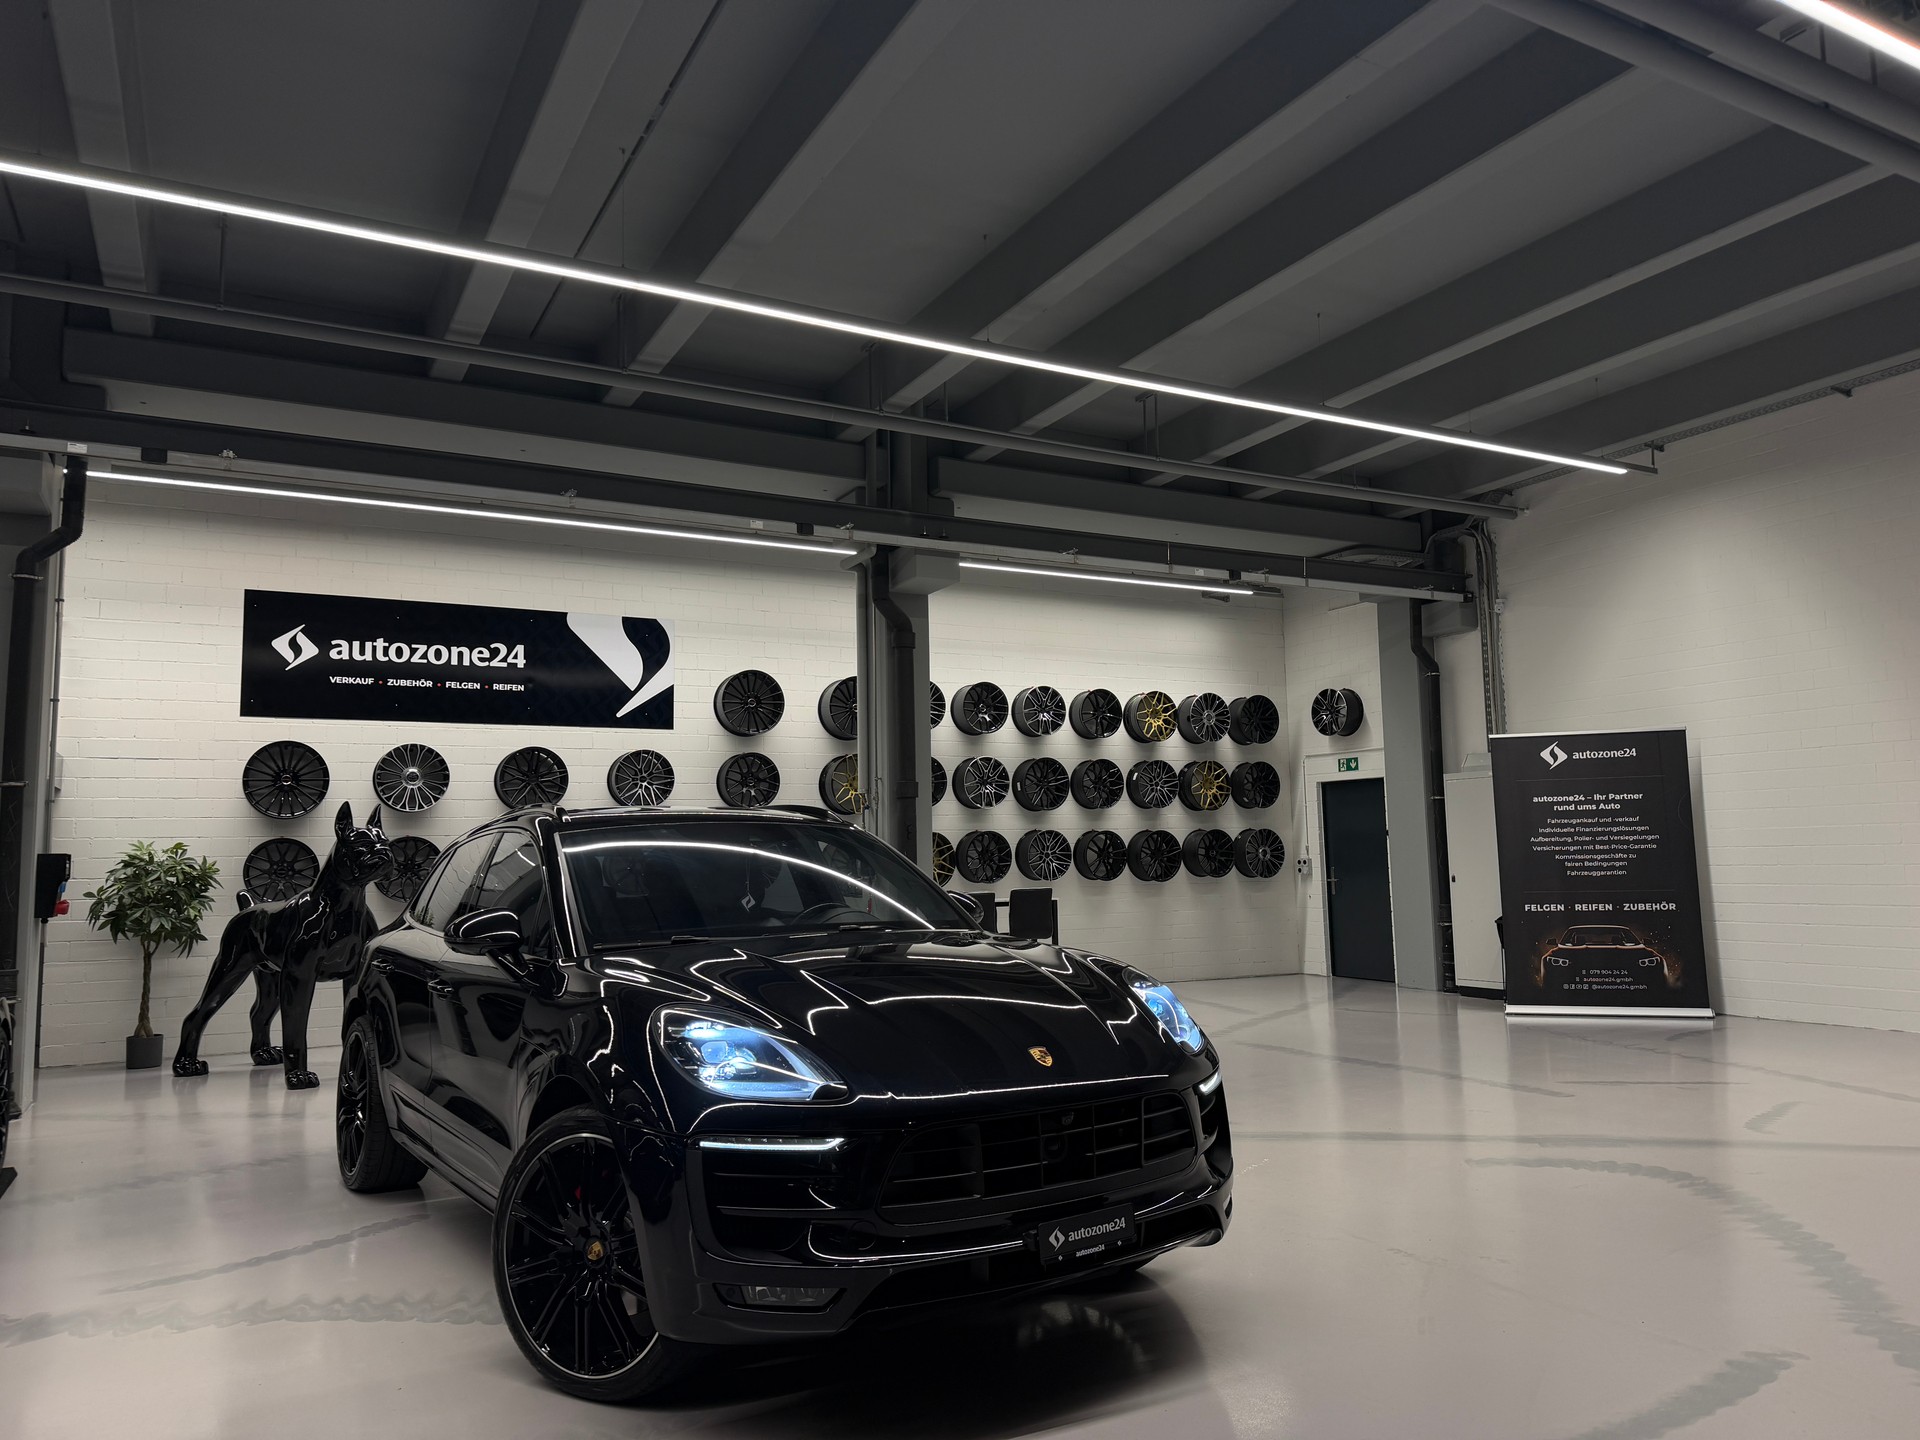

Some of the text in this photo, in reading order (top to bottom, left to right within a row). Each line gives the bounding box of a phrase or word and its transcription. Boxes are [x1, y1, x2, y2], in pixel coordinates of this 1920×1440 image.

[329, 637, 527, 669] autozone24
[329, 675, 525, 692] VERKAUF ZUBEHÖR FELGEN REIFEN
[1573, 748, 1636, 759] autozone24
[1532, 794, 1585, 803] autozone24
[1593, 793, 1607, 801] Ihr
[1608, 792, 1644, 801] Partner
[1553, 803, 1575, 811] rund
[1547, 817, 1598, 825] Fahrzeugankauf
[1575, 825, 1650, 833] Finanzierungslösungen
[1609, 834, 1660, 842] Versiegelungen
[1532, 844, 1582, 852] Versicherungen
[1584, 860, 1628, 868] Bedingungen
[1525, 901, 1676, 912] FELGEN REIFEN ZUBEHÖR
[1068, 1217, 1126, 1241] autozone24
[1076, 1244, 1105, 1257] autozone24
